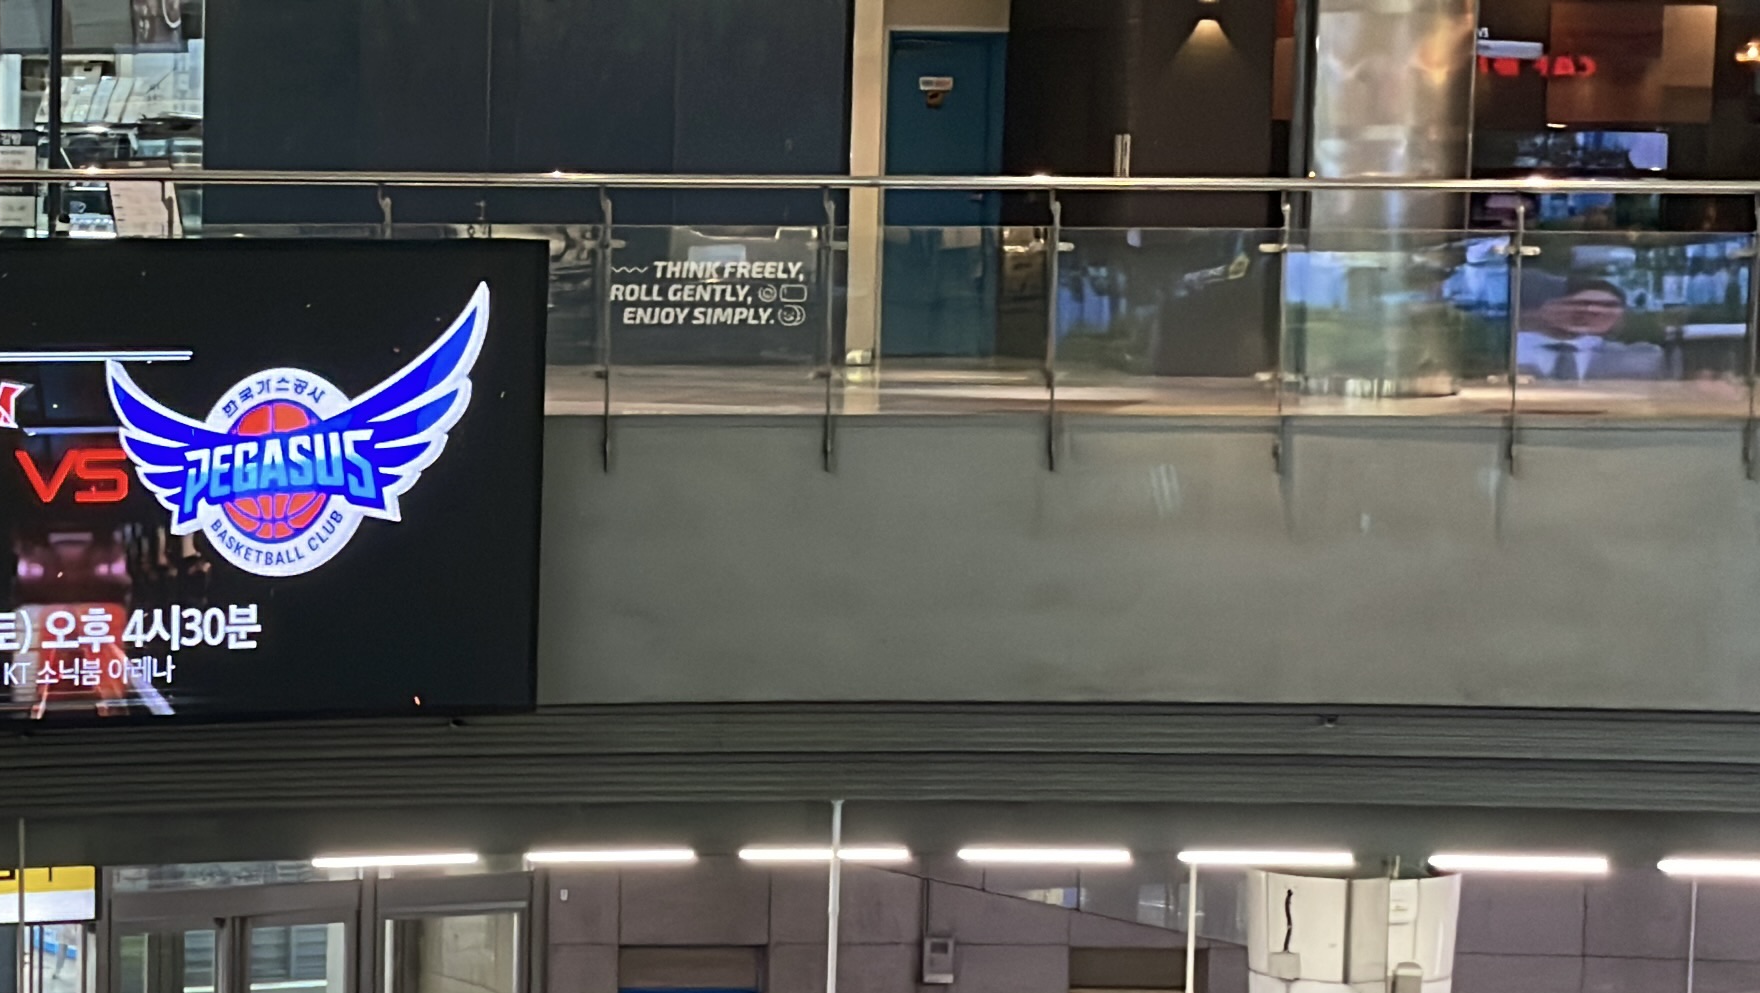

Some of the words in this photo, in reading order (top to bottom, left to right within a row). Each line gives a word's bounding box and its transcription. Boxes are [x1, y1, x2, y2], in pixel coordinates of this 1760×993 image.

[653, 261, 720, 279] THINK
[723, 261, 804, 282] FREELY,
[609, 284, 663, 301] ROLL
[667, 284, 752, 305] GENTLY,
[623, 307, 690, 325] ENJOY
[691, 307, 775, 325] SIMPLY.
[15, 448, 129, 503] VS
[184, 428, 377, 514] PEGASUS
[211, 518, 307, 567] BASKETBALL
[309, 509, 344, 553] CLUB
[41, 607, 116, 653] 오후
[122, 603, 262, 653] 4시30분
[3, 661, 31, 686] KT
[36, 657, 102, 688] 소닉붐
[108, 655, 176, 686] 아레나
